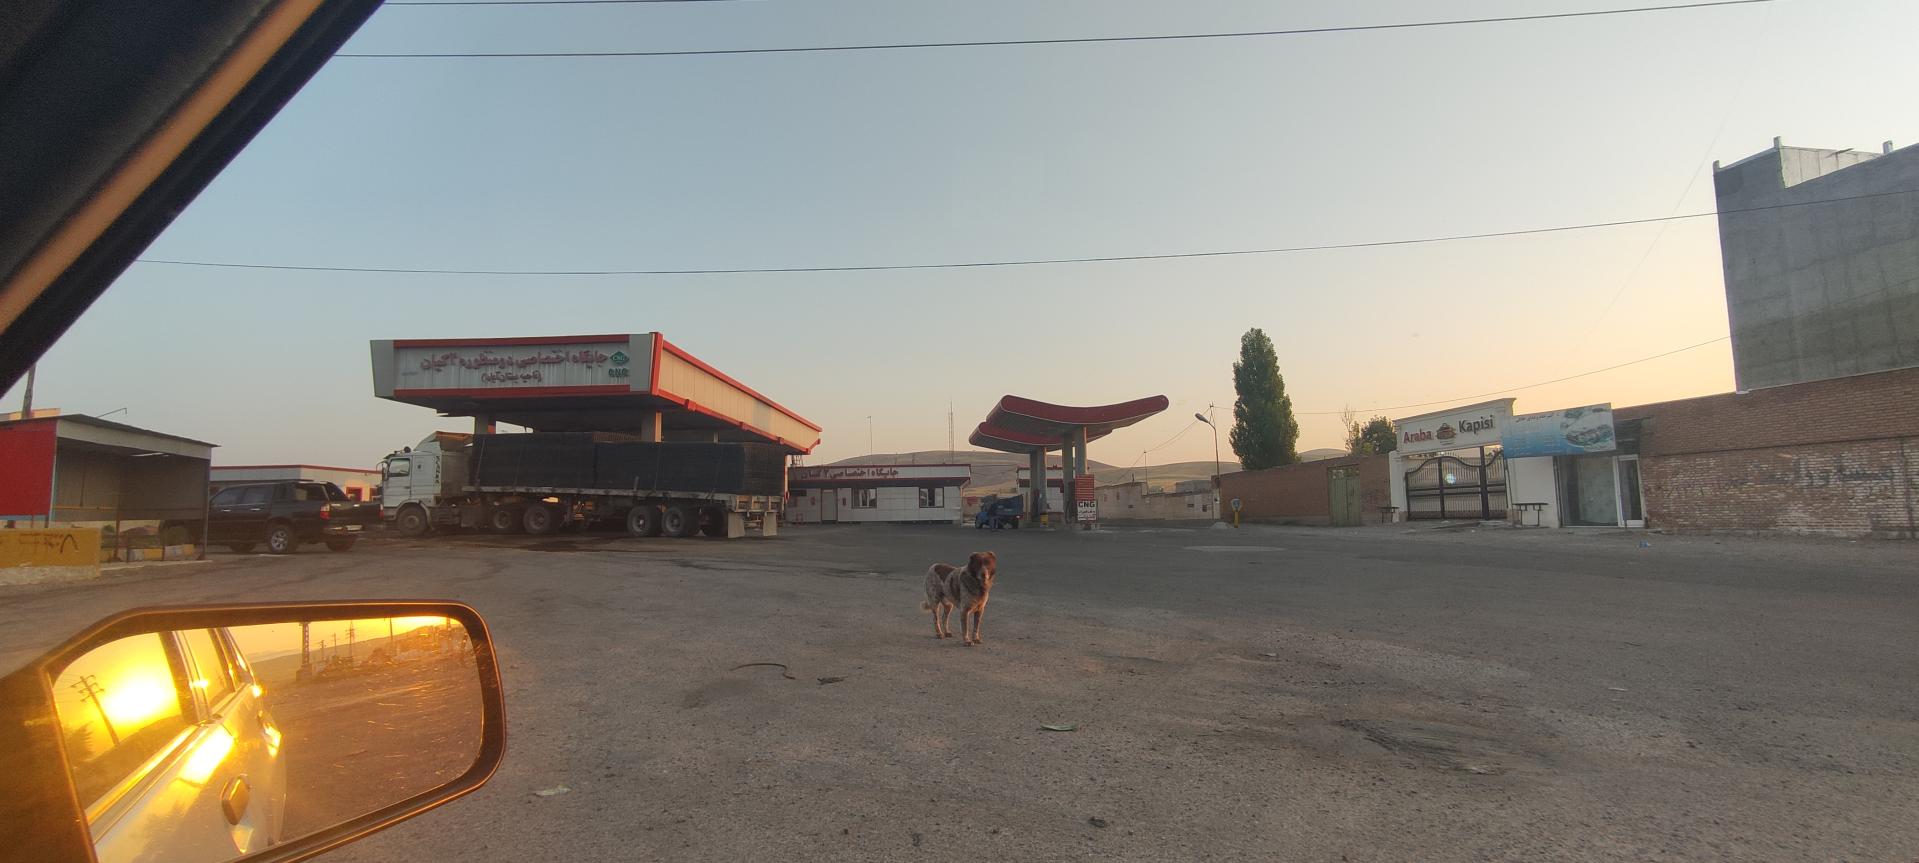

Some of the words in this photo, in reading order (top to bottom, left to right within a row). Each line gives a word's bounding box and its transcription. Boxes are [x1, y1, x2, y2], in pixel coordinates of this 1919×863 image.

[516, 349, 570, 369] اختصاصی
[571, 350, 608, 369] جایگاه
[1404, 428, 1432, 443] Araba
[830, 468, 870, 479] اختصاصی
[871, 467, 899, 479] جایگاه
